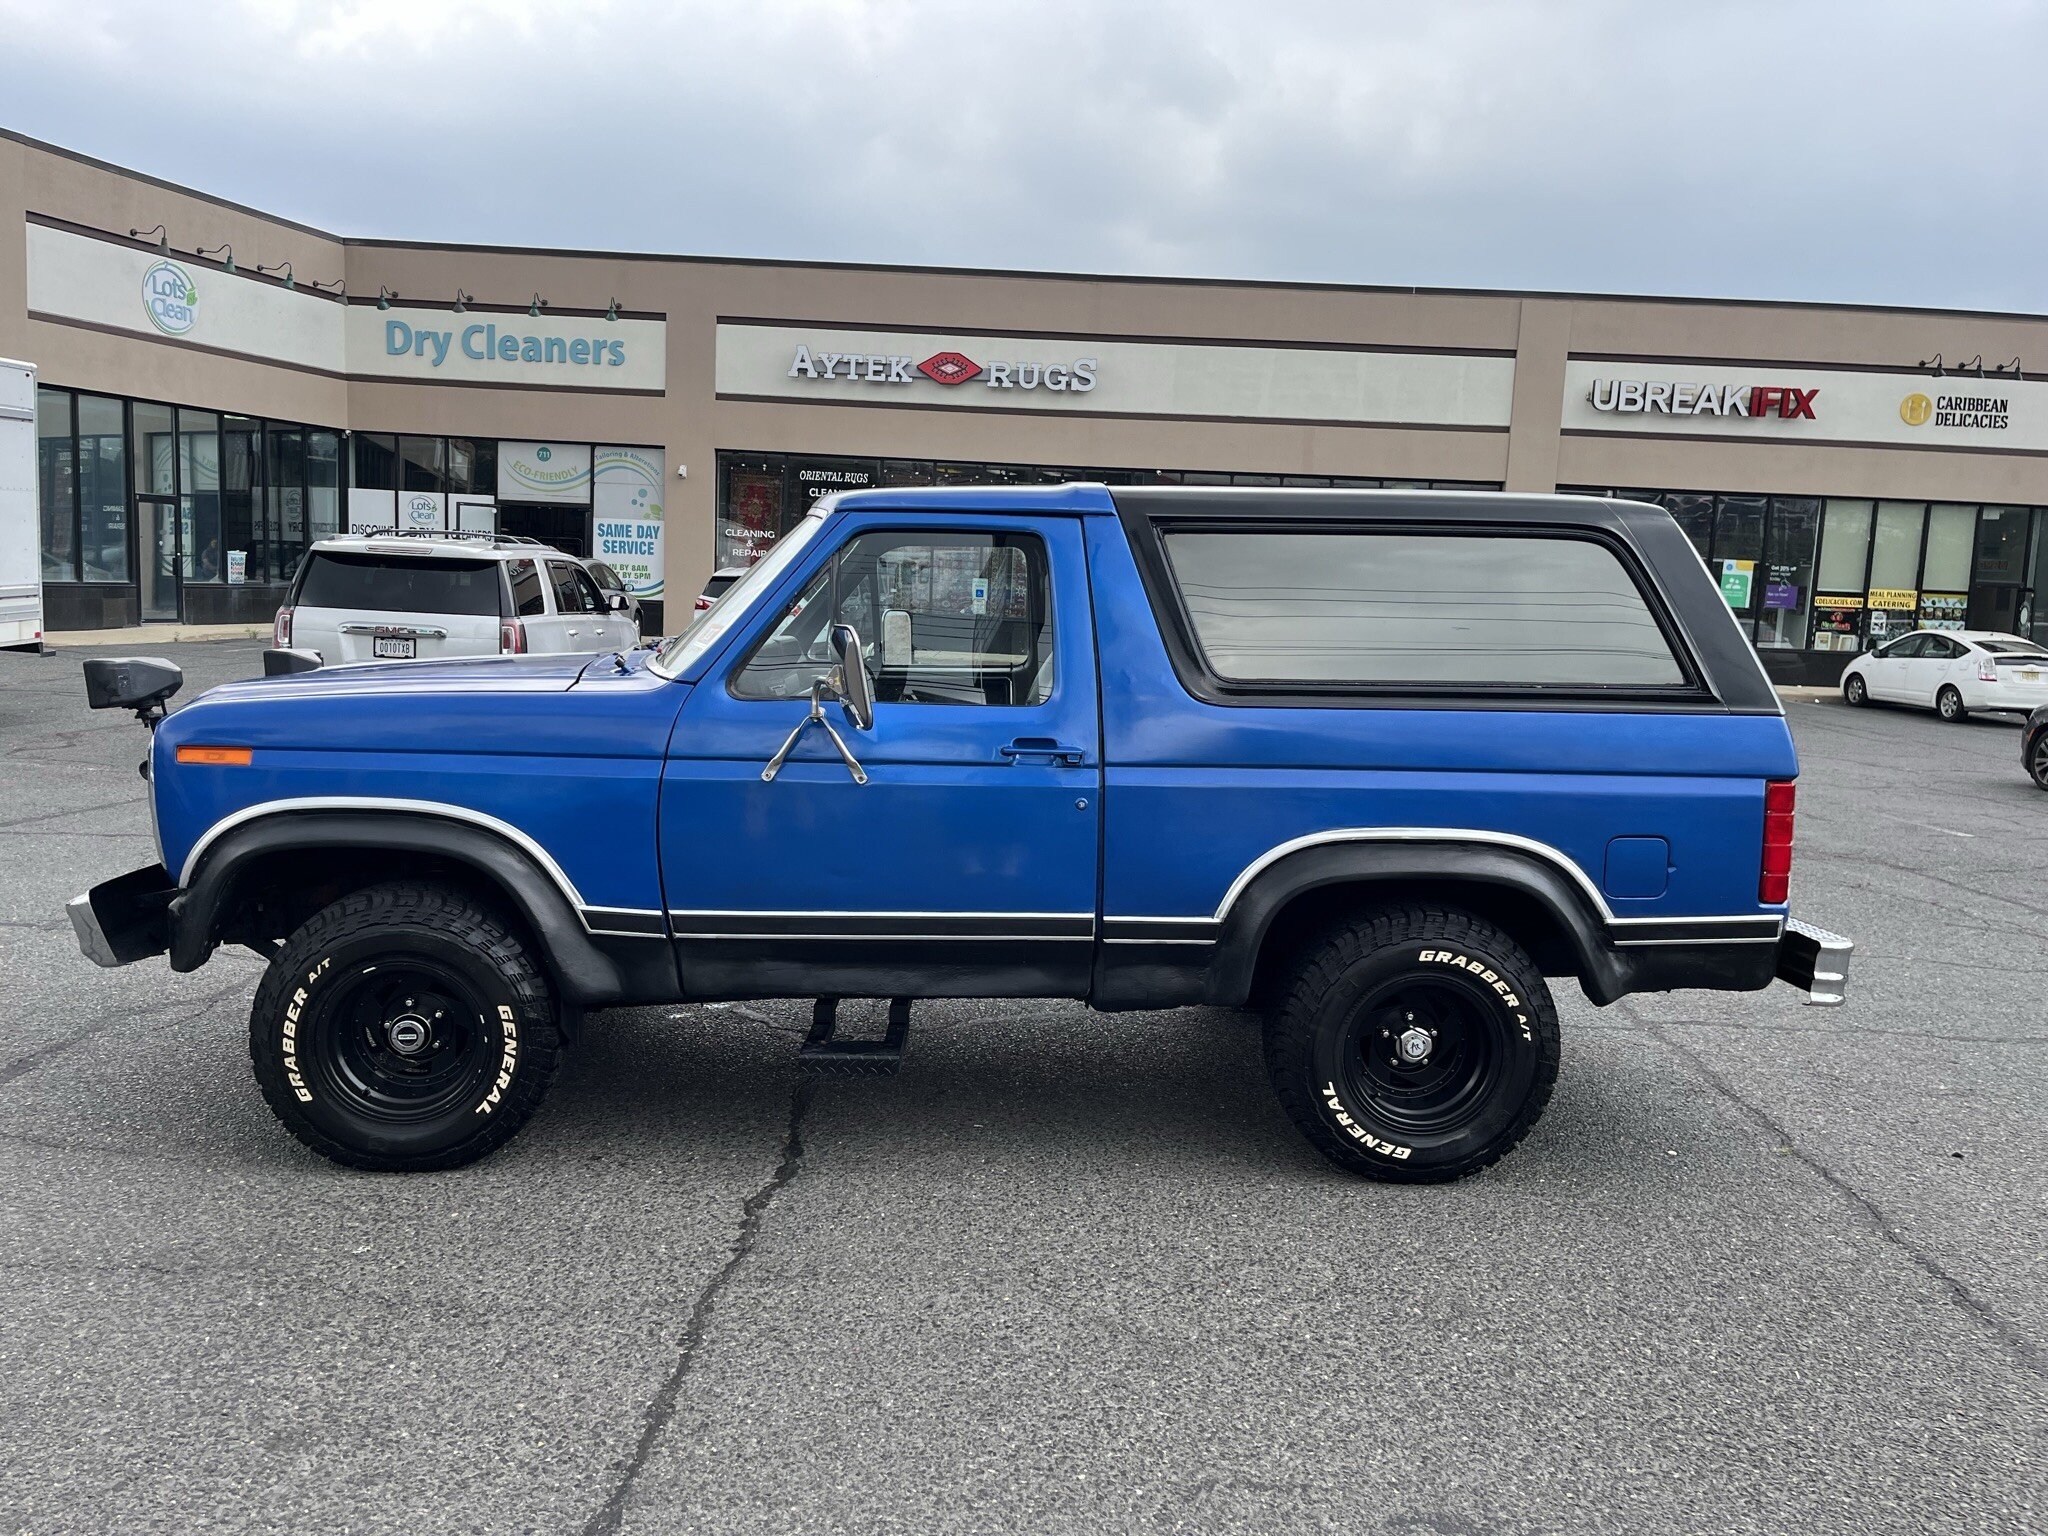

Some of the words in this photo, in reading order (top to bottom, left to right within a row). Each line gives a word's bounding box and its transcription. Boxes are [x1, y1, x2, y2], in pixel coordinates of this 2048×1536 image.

[152, 274, 187, 300] Lots
[151, 298, 194, 324] Clean
[386, 320, 453, 367] Dry
[461, 324, 626, 367] Cleaners
[787, 344, 914, 384] AYTEK
[986, 357, 1098, 393] RUGS
[1936, 395, 2009, 413] CARIBBEAN
[1934, 411, 2009, 429] DELICACIES
[538, 450, 550, 458] 711
[513, 460, 580, 482] ECO-FRIENDLY
[594, 451, 623, 462] Tailoring
[629, 453, 661, 477] Alterations
[799, 470, 843, 482] ORIENTAL
[844, 472, 869, 484] RUGS
[411, 501, 431, 511] Lots
[411, 511, 435, 521] Clean
[351, 523, 395, 537] DISCOUNT
[408, 526, 435, 539] DRY
[597, 523, 632, 538] SAME
[636, 525, 661, 540] DAY
[725, 528, 775, 538] CLEANING
[602, 539, 655, 556] SERVICE
[746, 539, 754, 547] &
[732, 548, 767, 558] REPAIR
[619, 563, 629, 571] BY
[631, 564, 648, 572] 8AM
[622, 571, 632, 579] BY
[634, 572, 651, 580] 5PM
[1869, 590, 1885, 598] MEAL
[1886, 591, 1916, 599] PLANNING
[1872, 600, 1911, 608] CATERING
[1418, 949, 1520, 1008] GRABBER
[1517, 1013, 1532, 1042] A/T
[282, 987, 313, 1102] GRABBER
[308, 957, 331, 984] A/T
[475, 1004, 518, 1115] GENERAL
[1322, 1081, 1412, 1160] GENERAL
